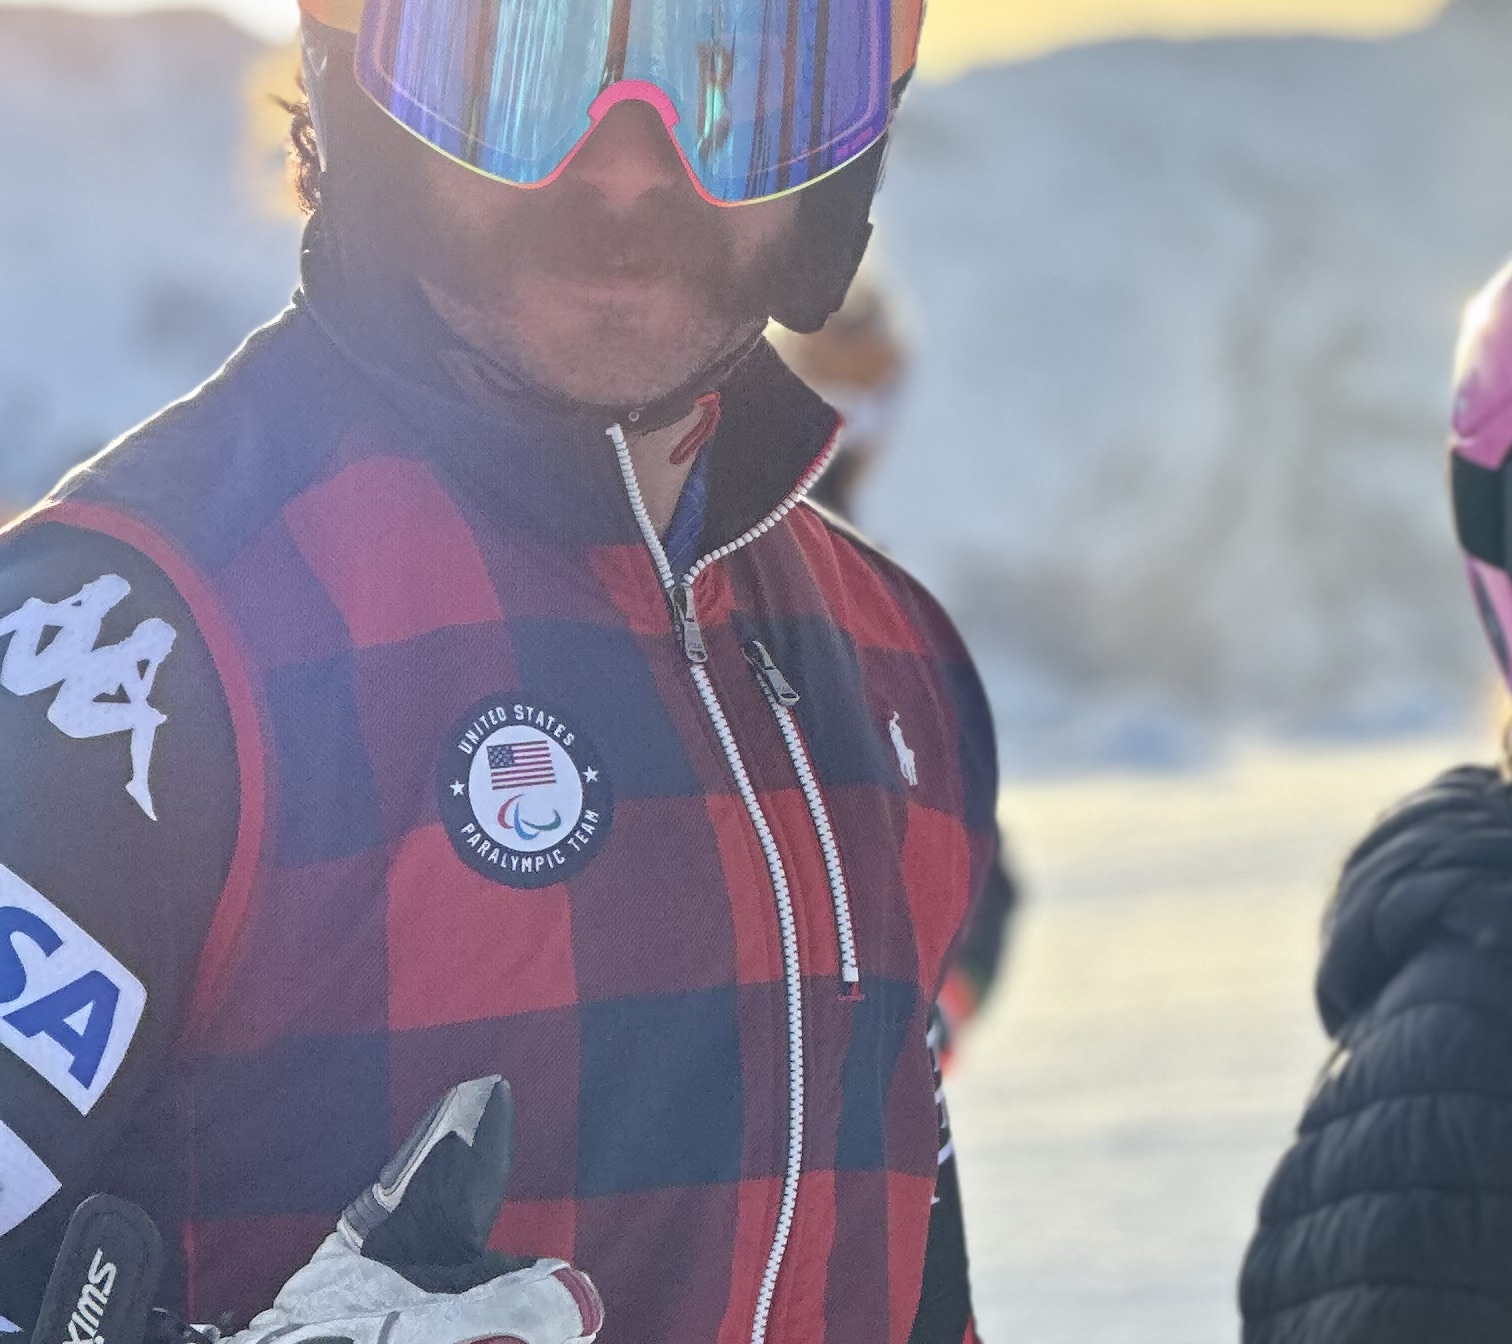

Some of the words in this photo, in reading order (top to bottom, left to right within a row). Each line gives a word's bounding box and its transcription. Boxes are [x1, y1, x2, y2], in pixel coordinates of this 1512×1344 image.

[457, 706, 507, 755] UNITED
[513, 703, 575, 748] STATES
[460, 822, 567, 873] PARALYMPIC
[567, 808, 600, 852] TEAM
